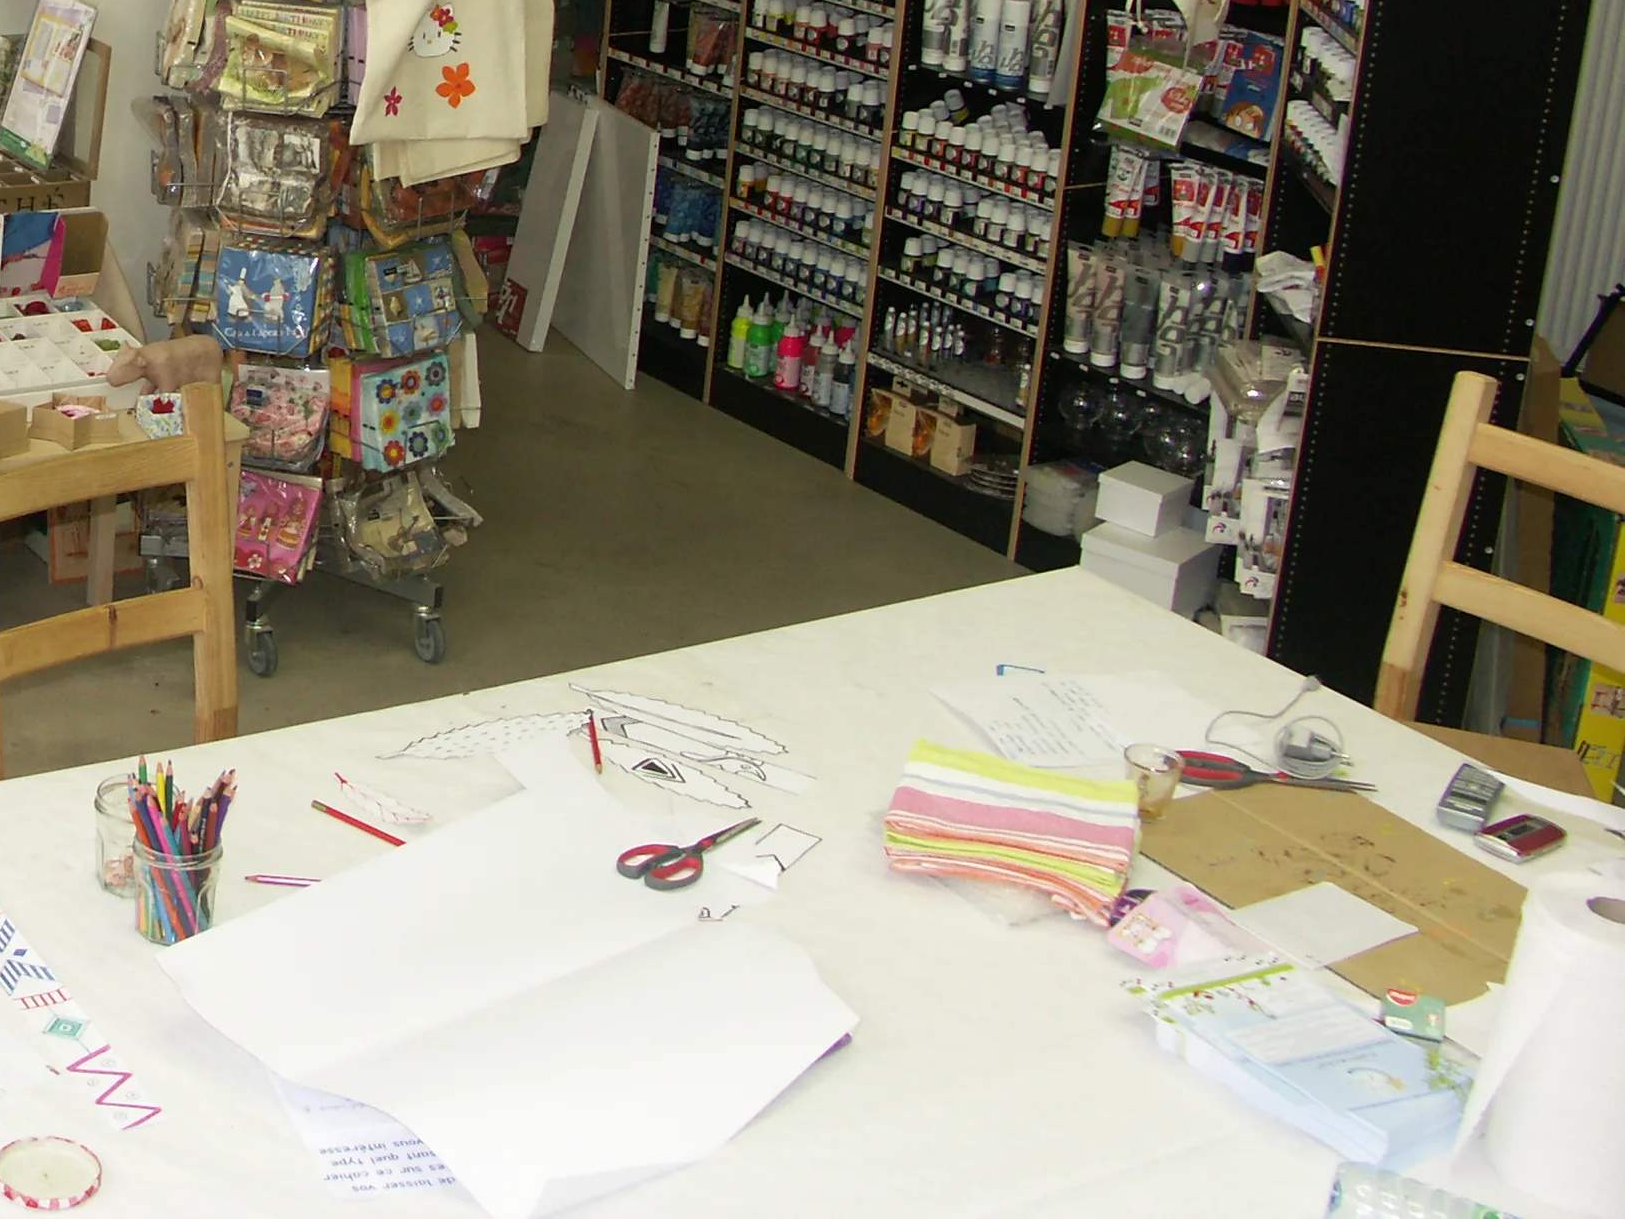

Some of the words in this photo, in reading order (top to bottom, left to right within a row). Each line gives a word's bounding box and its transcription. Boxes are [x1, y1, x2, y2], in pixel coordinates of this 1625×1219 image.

[319, 1142, 388, 1155] intéresse
[331, 1156, 364, 1167] type
[400, 1165, 423, 1174] sur
[323, 1170, 370, 1181] cahier
